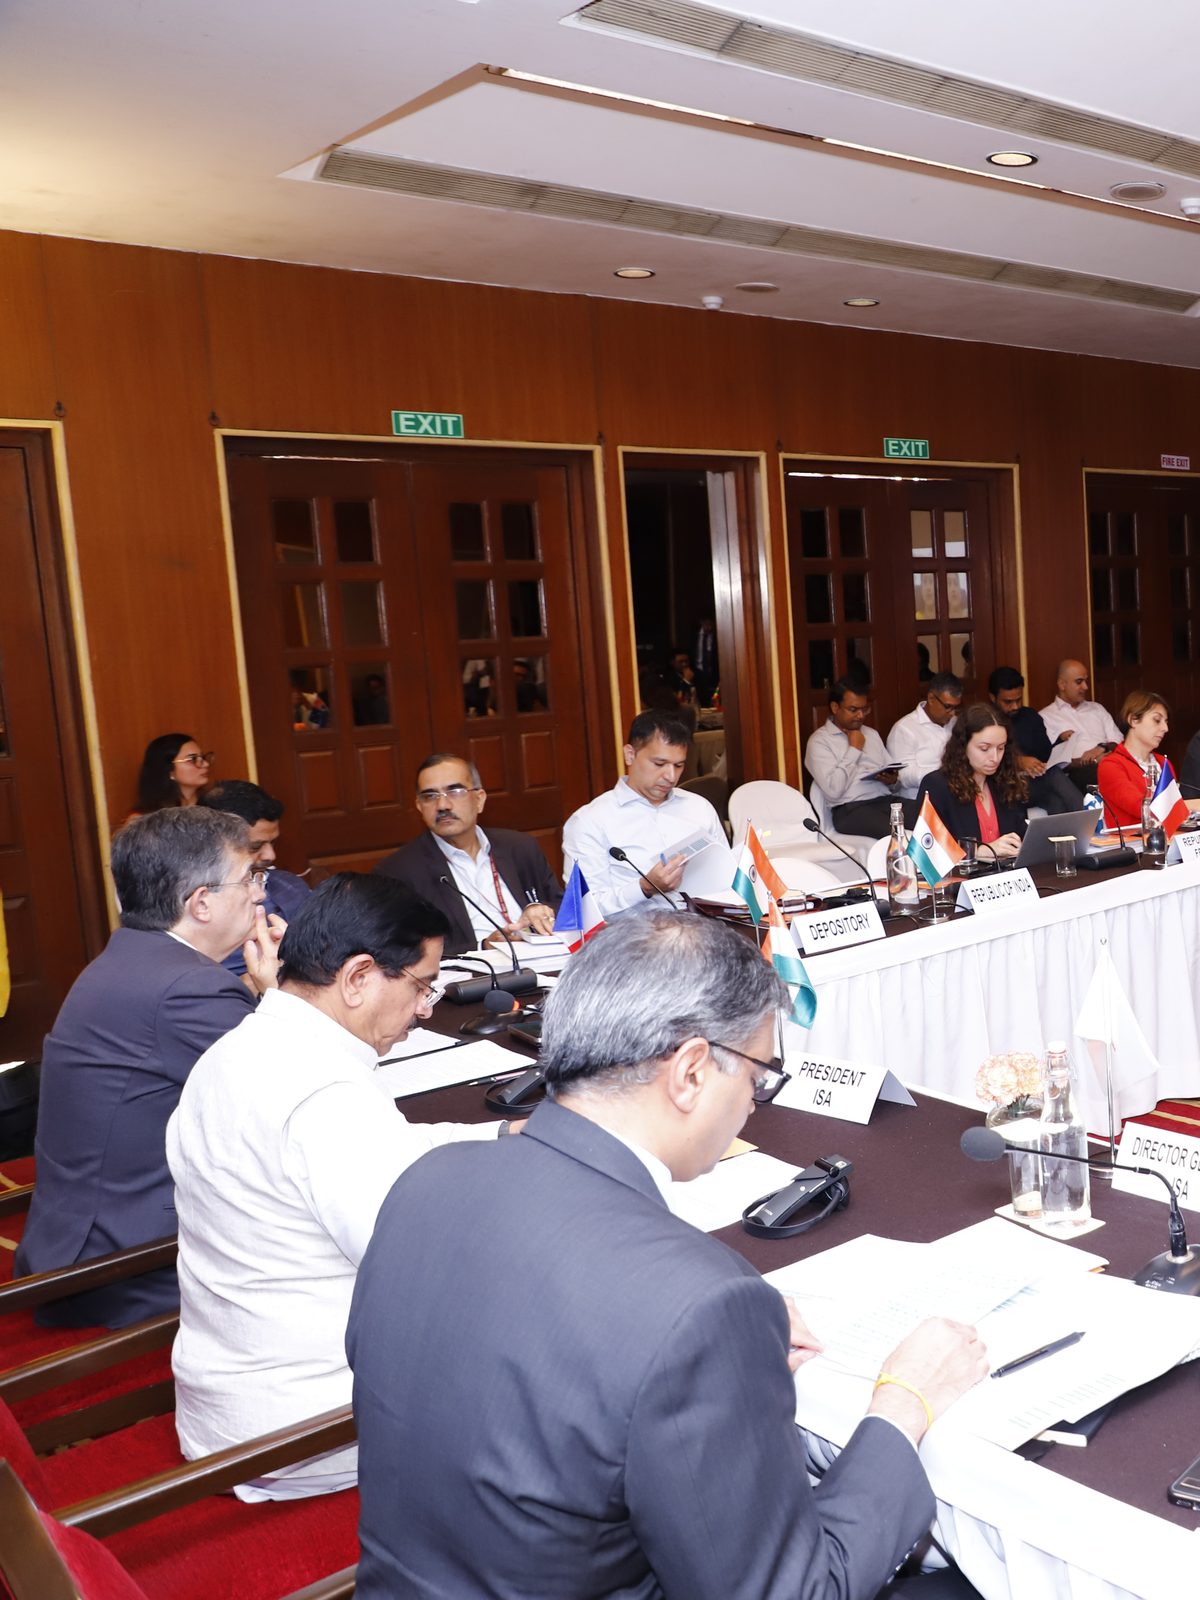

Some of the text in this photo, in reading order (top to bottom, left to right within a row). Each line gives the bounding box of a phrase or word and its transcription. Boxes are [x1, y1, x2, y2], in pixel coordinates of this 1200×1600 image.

[399, 414, 459, 435] EXIT
[888, 440, 926, 457] EXIT
[1162, 456, 1188, 468] FIRE EXIT
[971, 877, 1033, 903] REPUBLIC OF INDIA
[809, 913, 871, 940] DEPOSITORY
[799, 1061, 867, 1087] PRESIDENT
[812, 1088, 832, 1107] ISA
[1132, 1137, 1188, 1168] DIRECTOR
